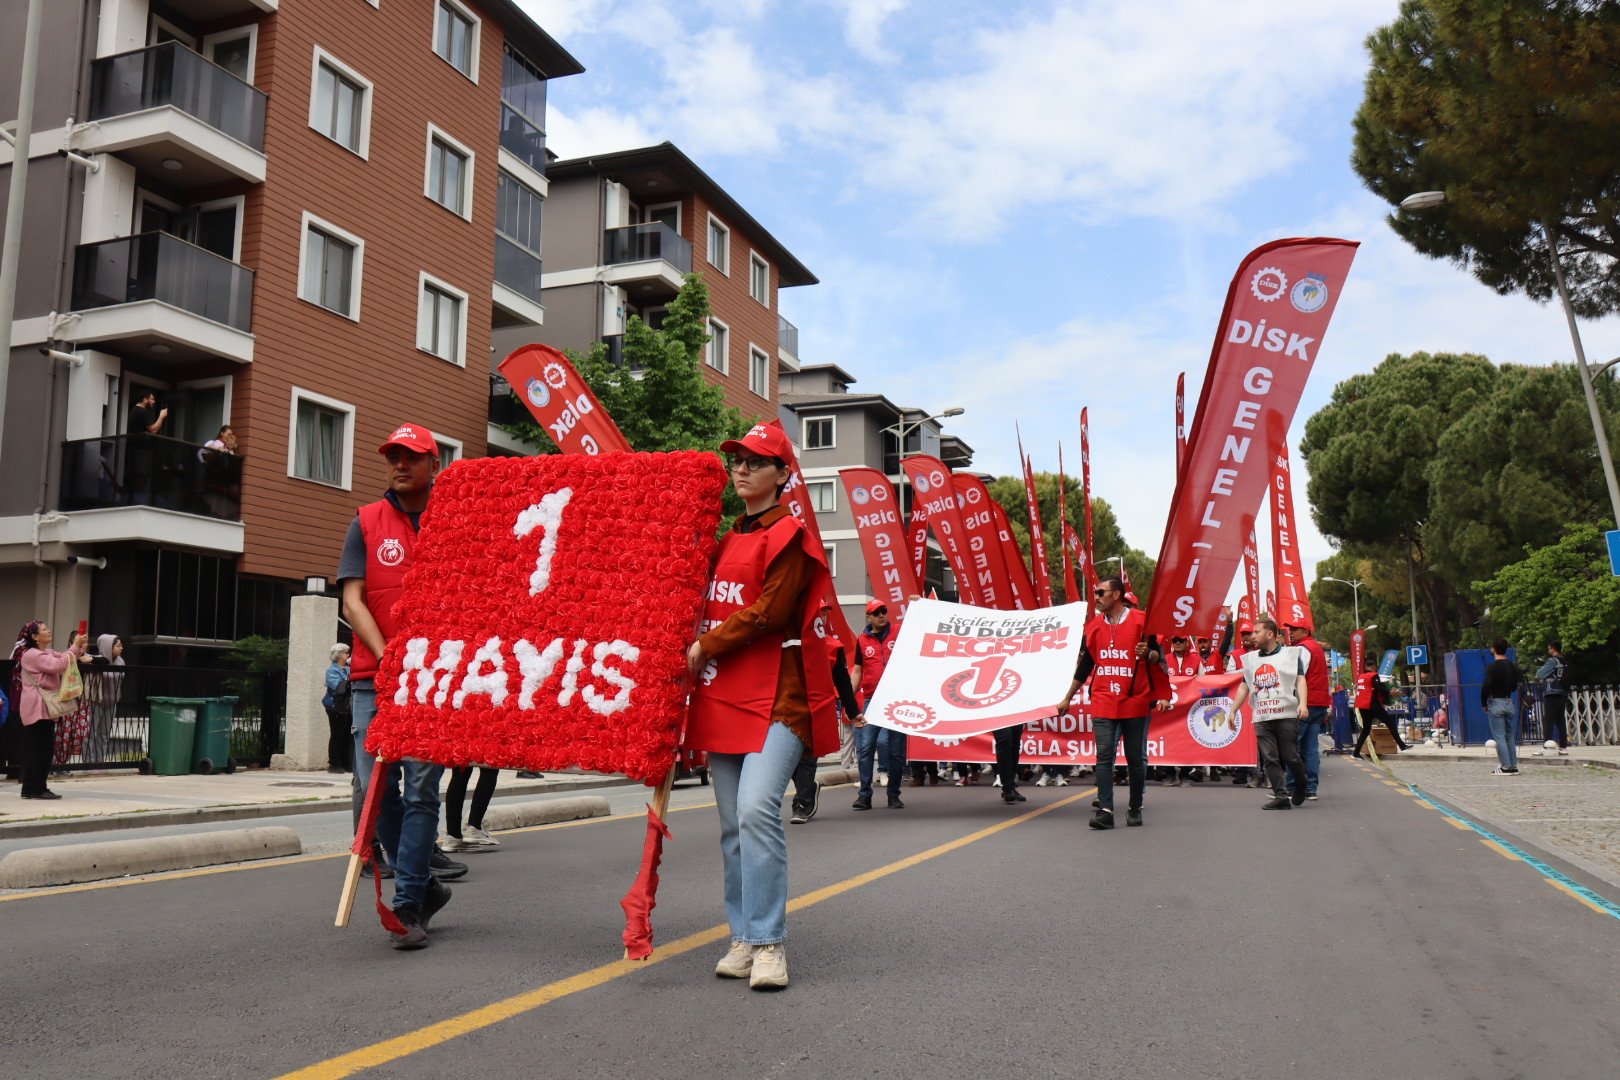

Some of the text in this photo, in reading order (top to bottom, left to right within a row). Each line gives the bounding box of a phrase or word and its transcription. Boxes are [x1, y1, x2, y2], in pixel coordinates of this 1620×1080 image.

[1228, 319, 1316, 361] DİSK
[513, 487, 573, 597] 1
[937, 621, 1062, 638] BU DÜZEN
[920, 626, 1070, 659] DEĞİŞİR!
[1100, 647, 1129, 660] DİSK
[1410, 648, 1423, 663] P
[394, 636, 640, 717] MAYIS
[1097, 665, 1133, 678] GENEL
[1110, 680, 1121, 695] İŞ
[896, 709, 924, 719] DİSK
